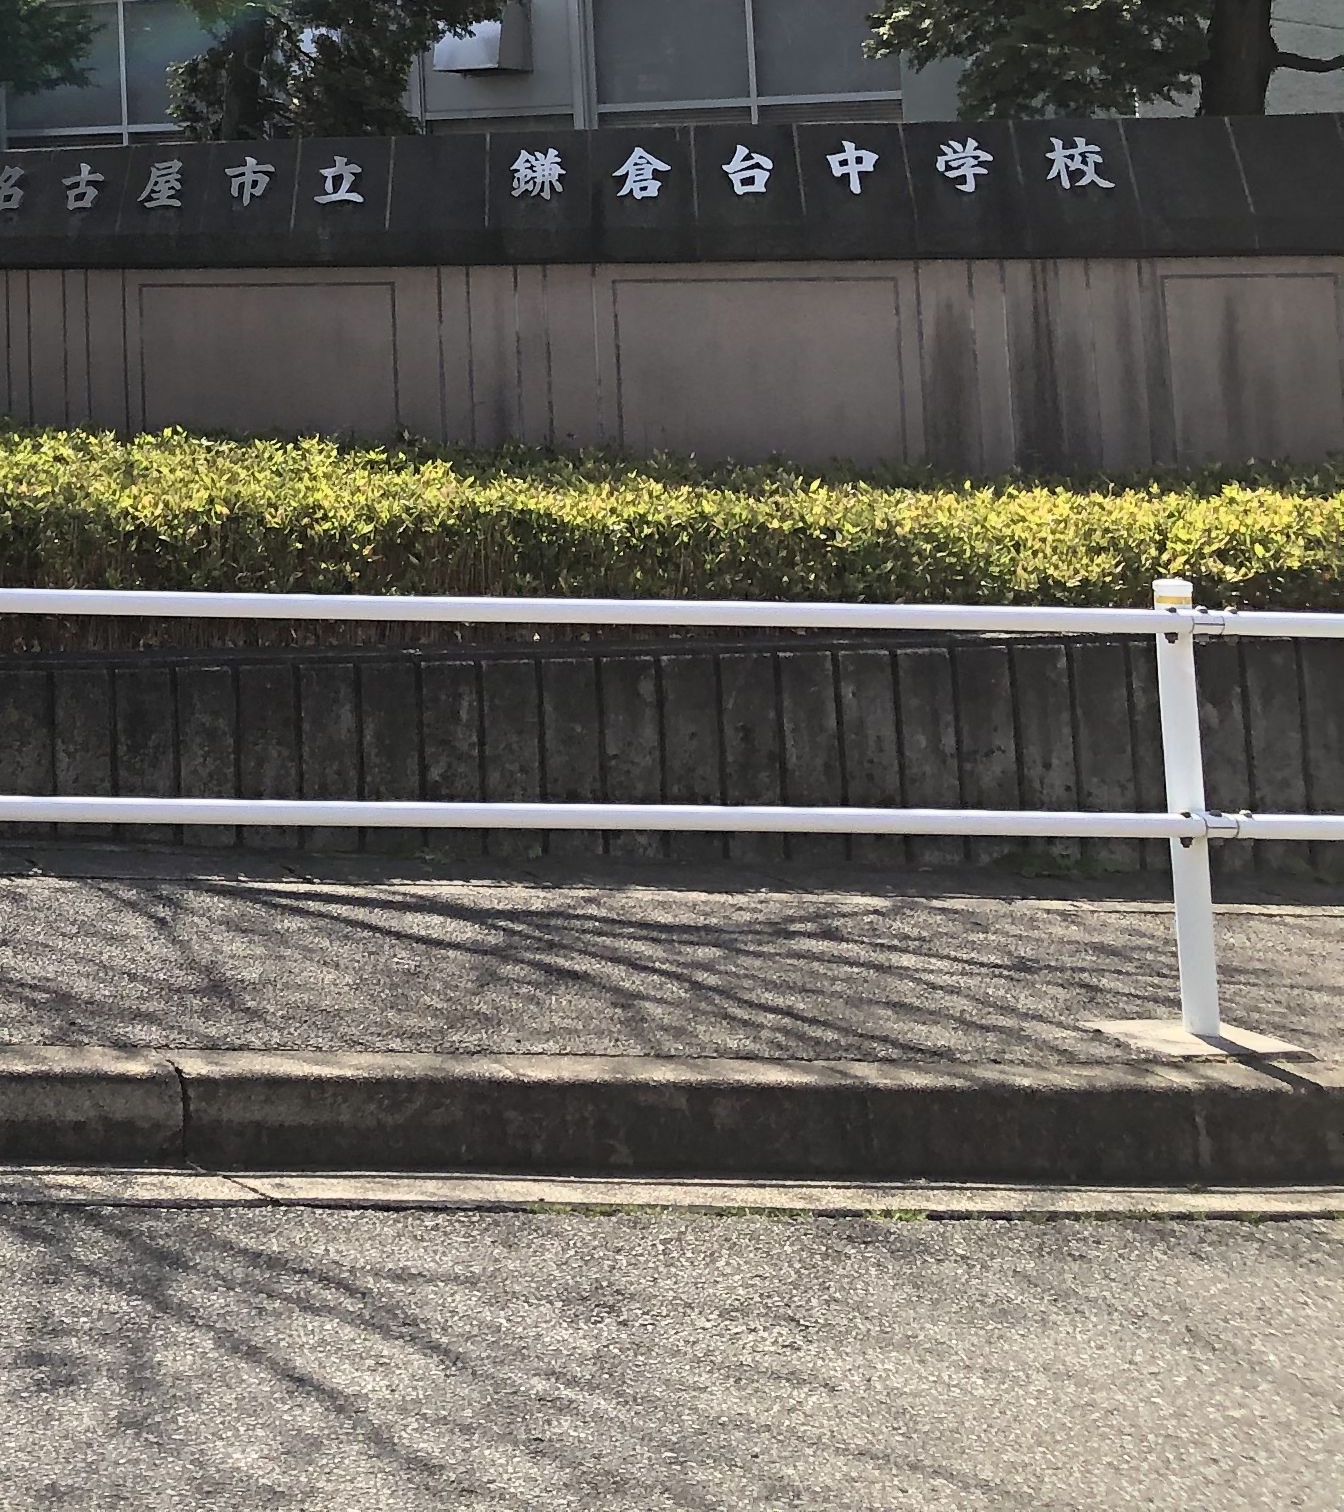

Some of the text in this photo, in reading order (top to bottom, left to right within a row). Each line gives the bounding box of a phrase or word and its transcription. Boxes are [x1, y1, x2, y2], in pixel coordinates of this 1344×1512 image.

[509, 135, 1116, 202] 鎌倉台中学校
